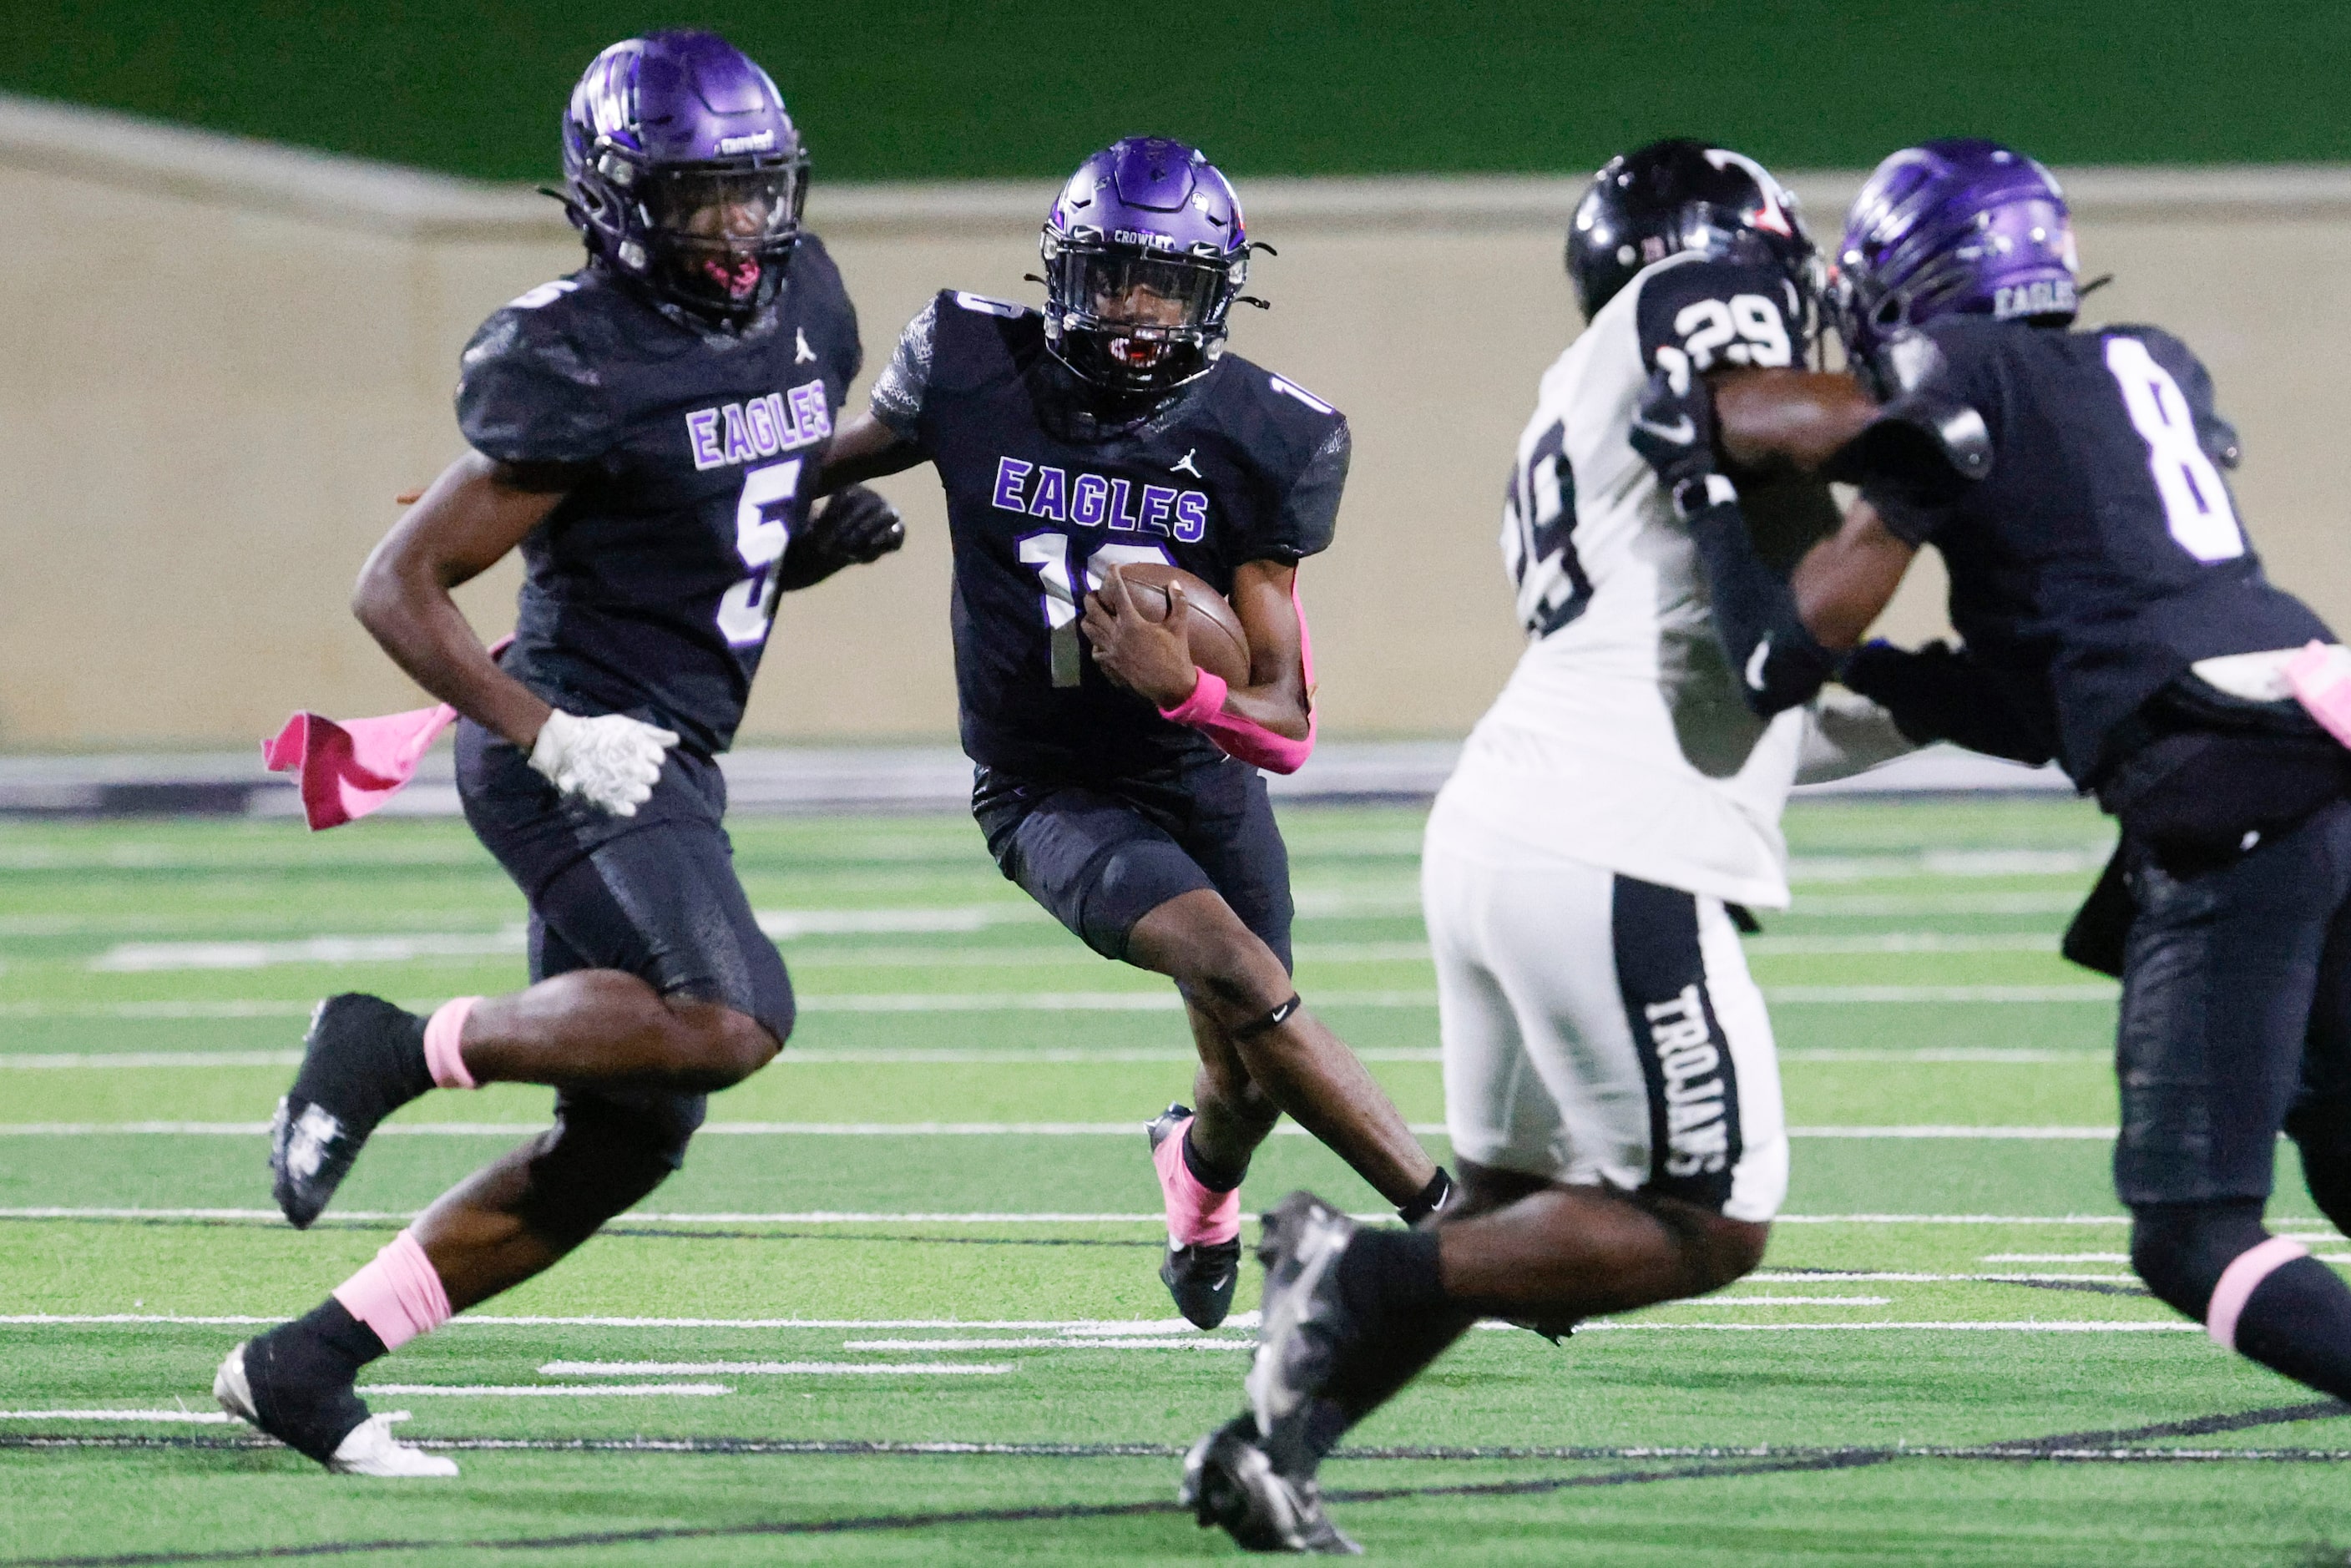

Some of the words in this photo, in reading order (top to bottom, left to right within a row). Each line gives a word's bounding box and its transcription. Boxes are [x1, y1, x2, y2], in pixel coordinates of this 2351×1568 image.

[1672, 292, 1792, 373] 29
[685, 379, 832, 472] EAGLES
[1268, 372, 1336, 415] 1
[2102, 334, 2246, 564] 8
[992, 455, 1209, 544] EAGLES
[715, 459, 803, 649] 5
[1644, 984, 1728, 1177] TROJANS
